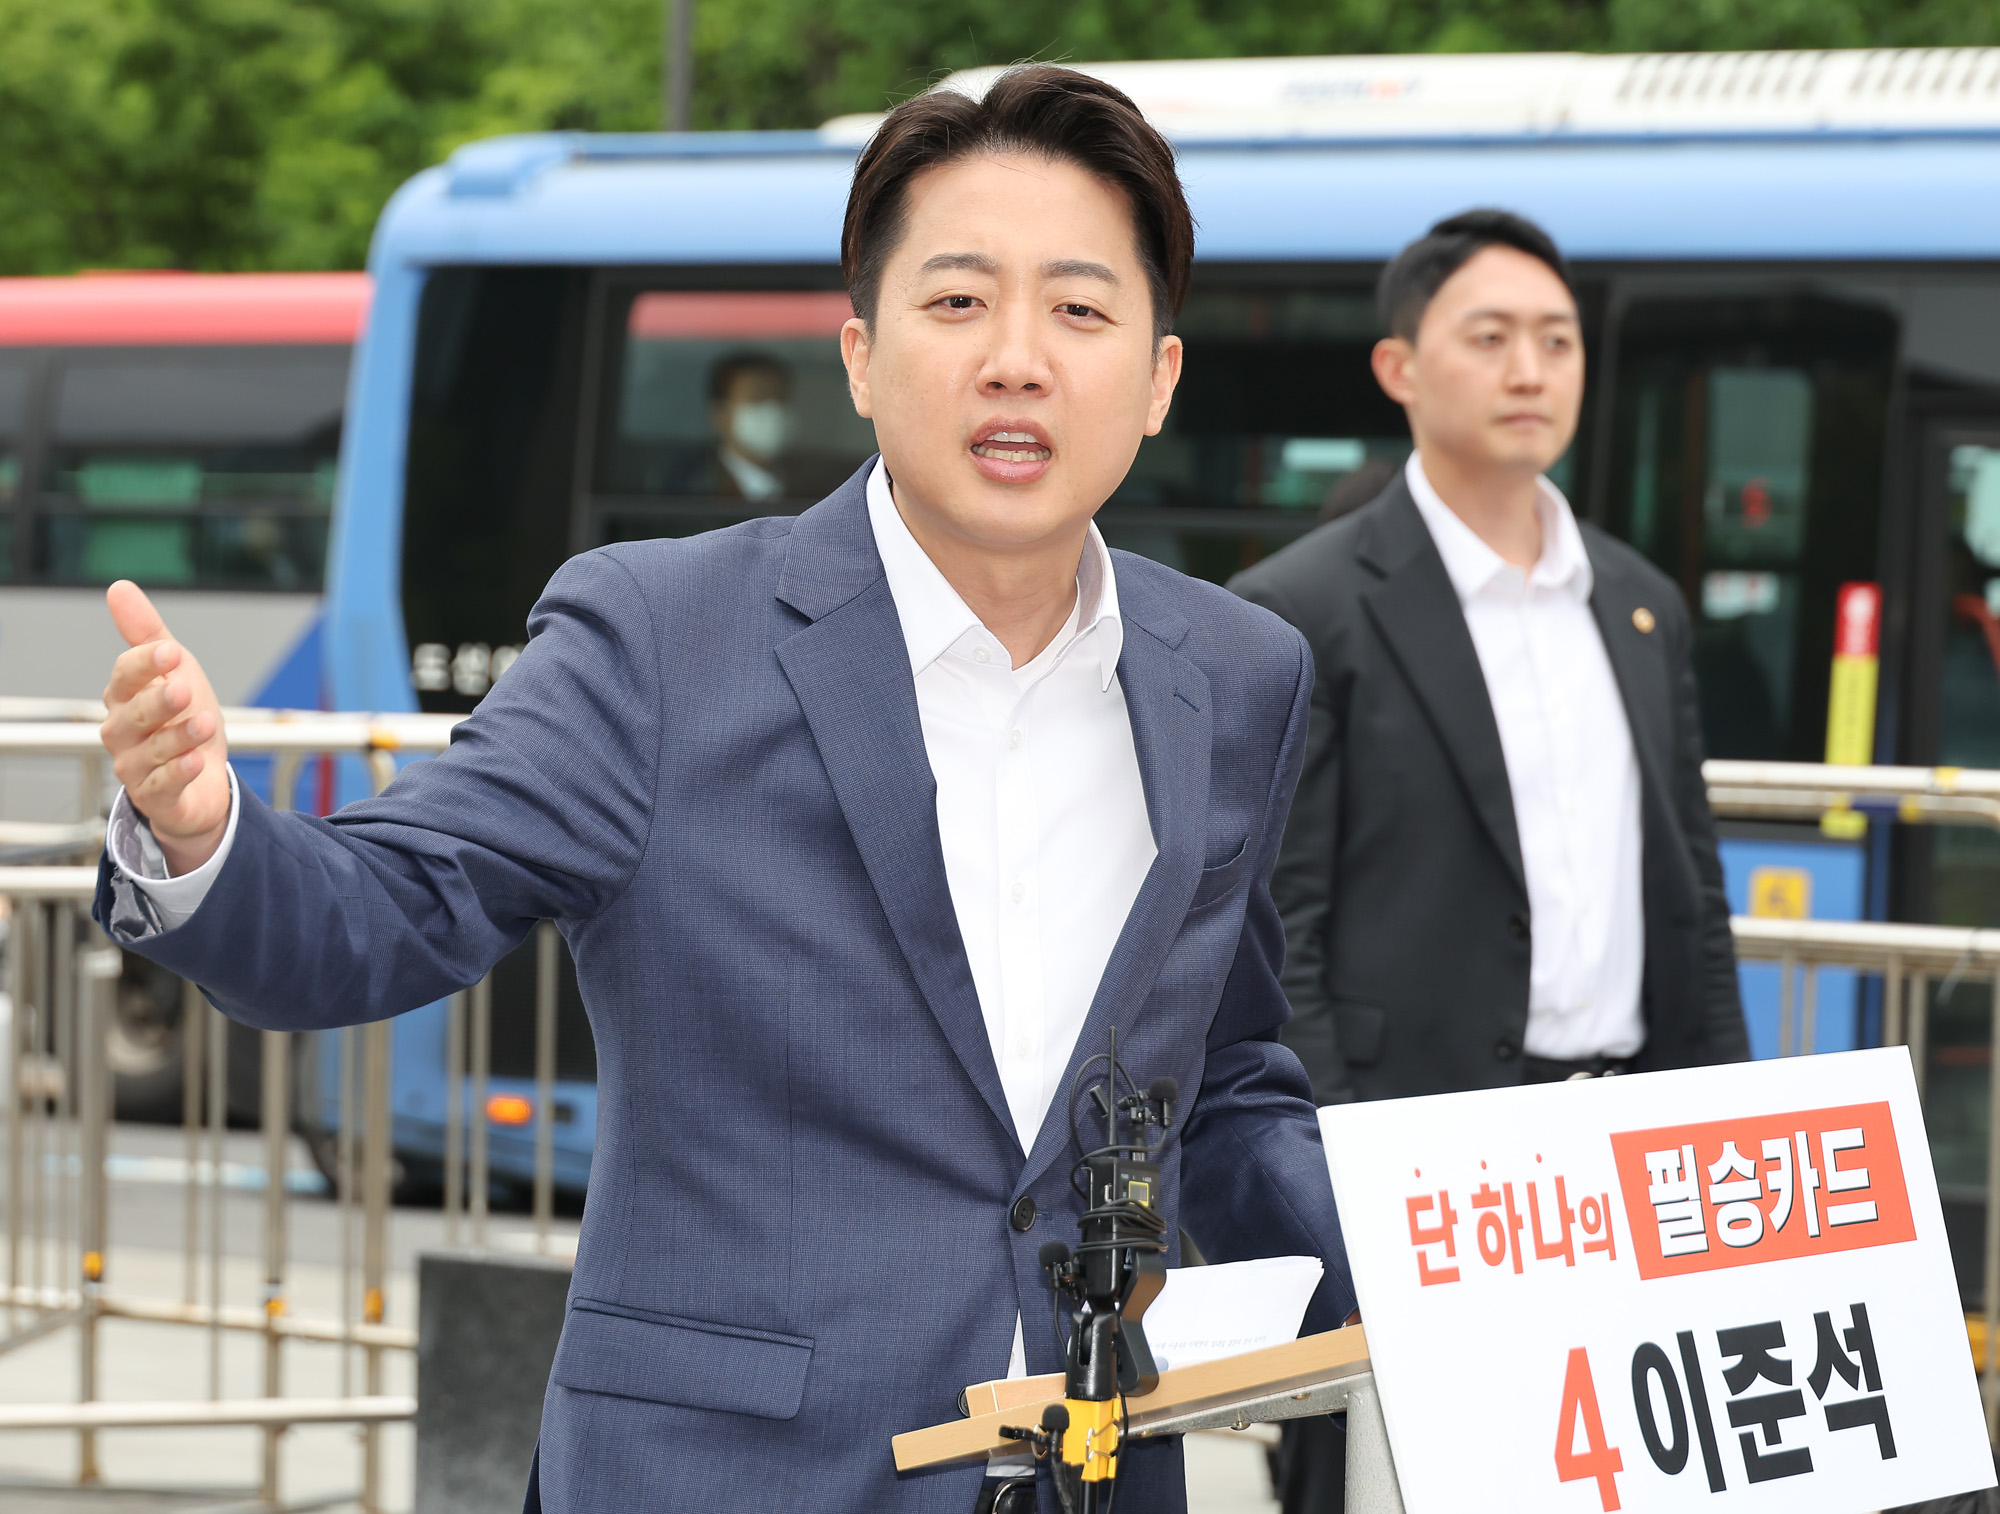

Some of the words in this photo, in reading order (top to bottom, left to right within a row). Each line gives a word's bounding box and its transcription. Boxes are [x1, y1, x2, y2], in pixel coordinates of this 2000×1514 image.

[1405, 1188, 1461, 1287] 단
[1470, 1174, 1617, 1275] 하나의
[1644, 1127, 1879, 1258] 필승카드
[1554, 1345, 1624, 1513] 4
[1631, 1301, 1898, 1494] 이준석
